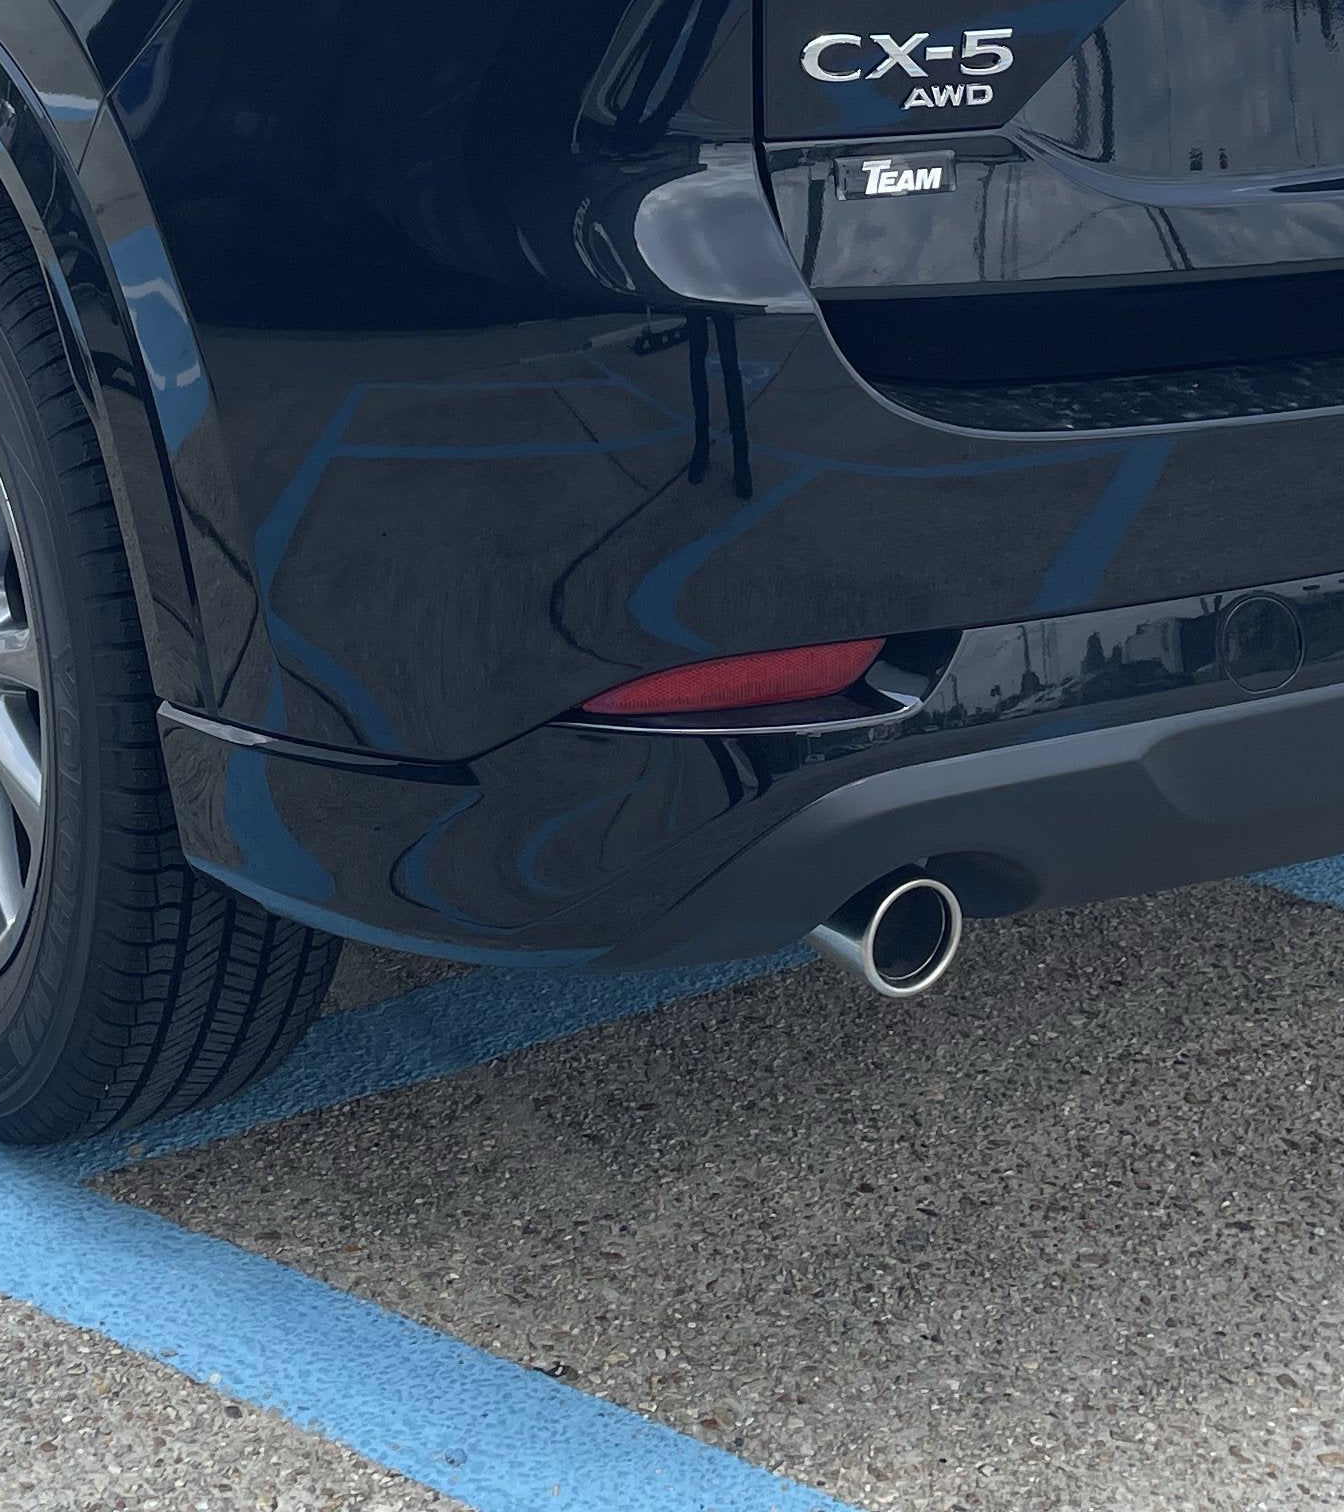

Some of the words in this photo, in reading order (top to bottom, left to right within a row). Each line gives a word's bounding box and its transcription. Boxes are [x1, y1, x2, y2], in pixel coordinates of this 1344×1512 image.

[801, 28, 1014, 82] CX-5
[901, 83, 994, 110] AWD
[861, 159, 943, 195] TEAM
[9, 643, 83, 1068] YOKOHAMA
